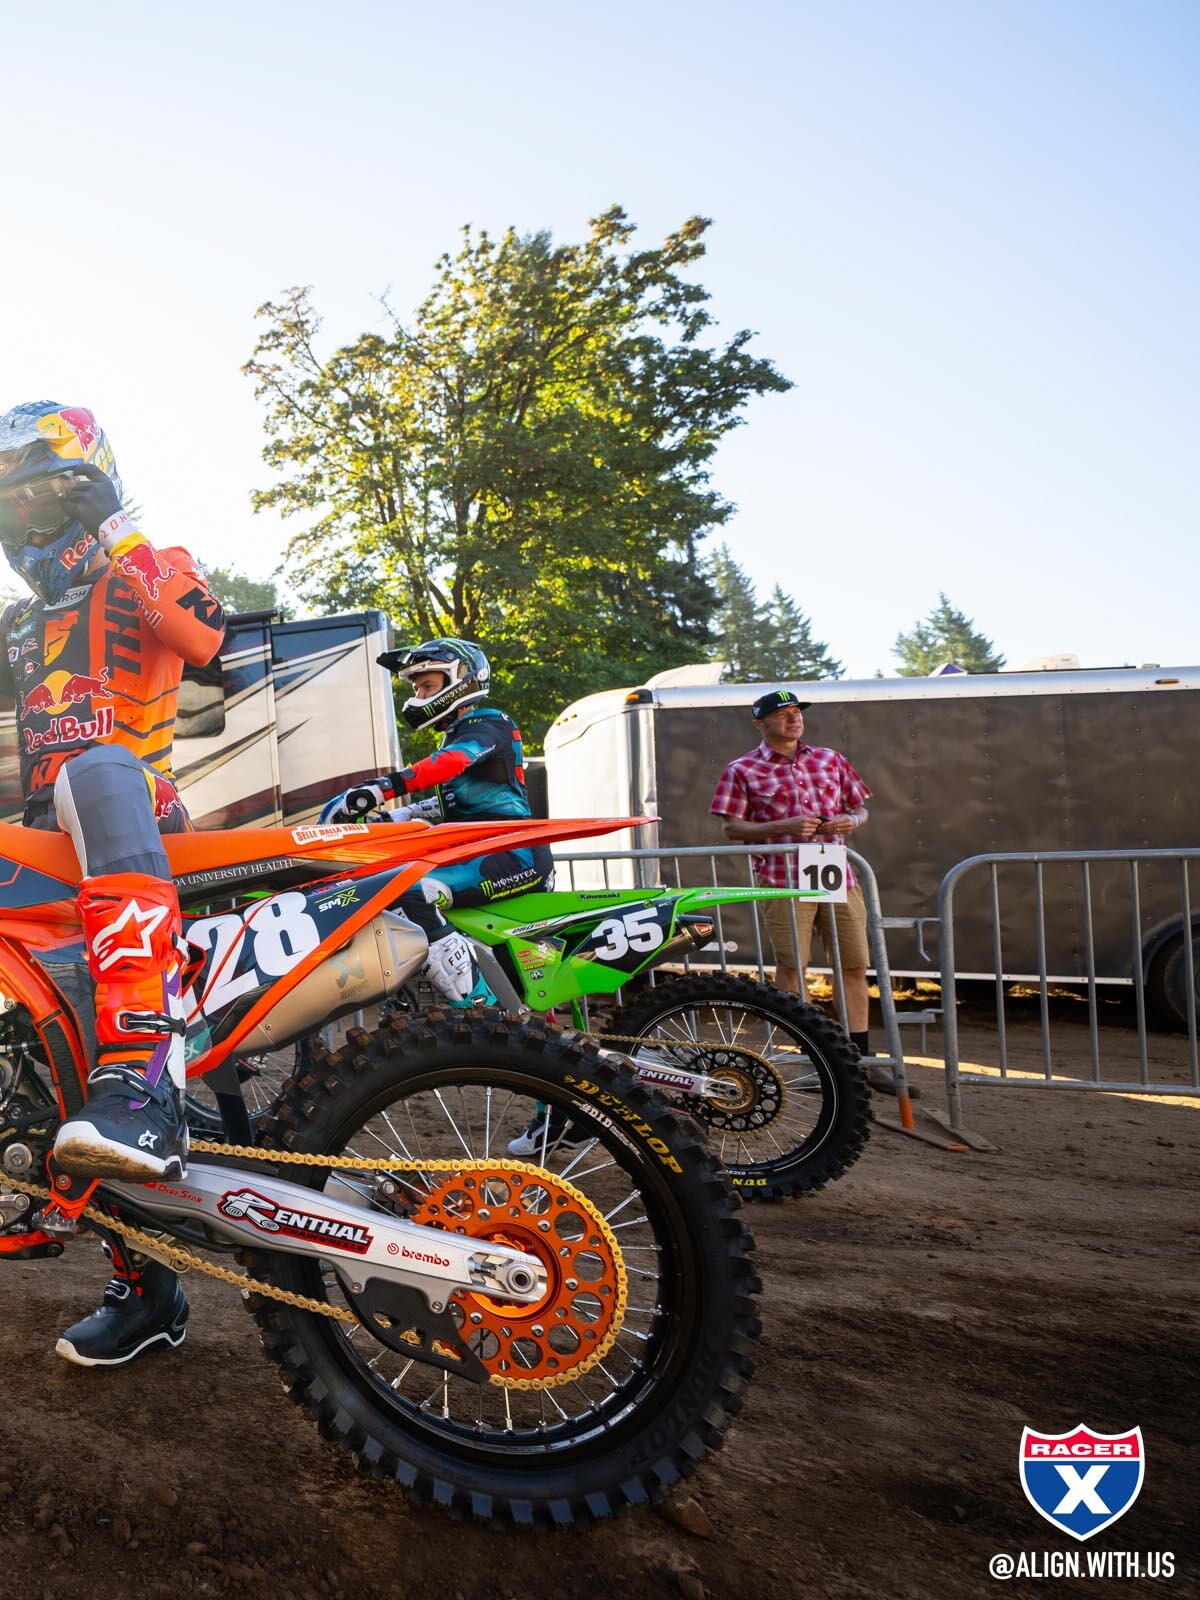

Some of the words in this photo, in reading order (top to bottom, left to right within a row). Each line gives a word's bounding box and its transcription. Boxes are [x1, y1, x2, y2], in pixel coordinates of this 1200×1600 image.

[22, 720, 58, 754] Red
[58, 706, 114, 742] Bull
[30, 748, 86, 793] KT
[295, 830, 318, 841] SELLE
[319, 826, 342, 836] DALLA
[188, 866, 249, 885] UNIVERSITY
[250, 858, 293, 874] HEALTH
[493, 868, 537, 889] MONSTER
[803, 864, 843, 891] 10
[318, 889, 360, 912] SMX
[580, 891, 621, 900] Kawasaki
[591, 907, 663, 960] 35
[186, 892, 321, 1017] 28
[448, 944, 467, 967] FOX
[632, 1068, 694, 1088] ENTHAL
[732, 1178, 767, 1186] DUN
[401, 1247, 450, 1268] brembo
